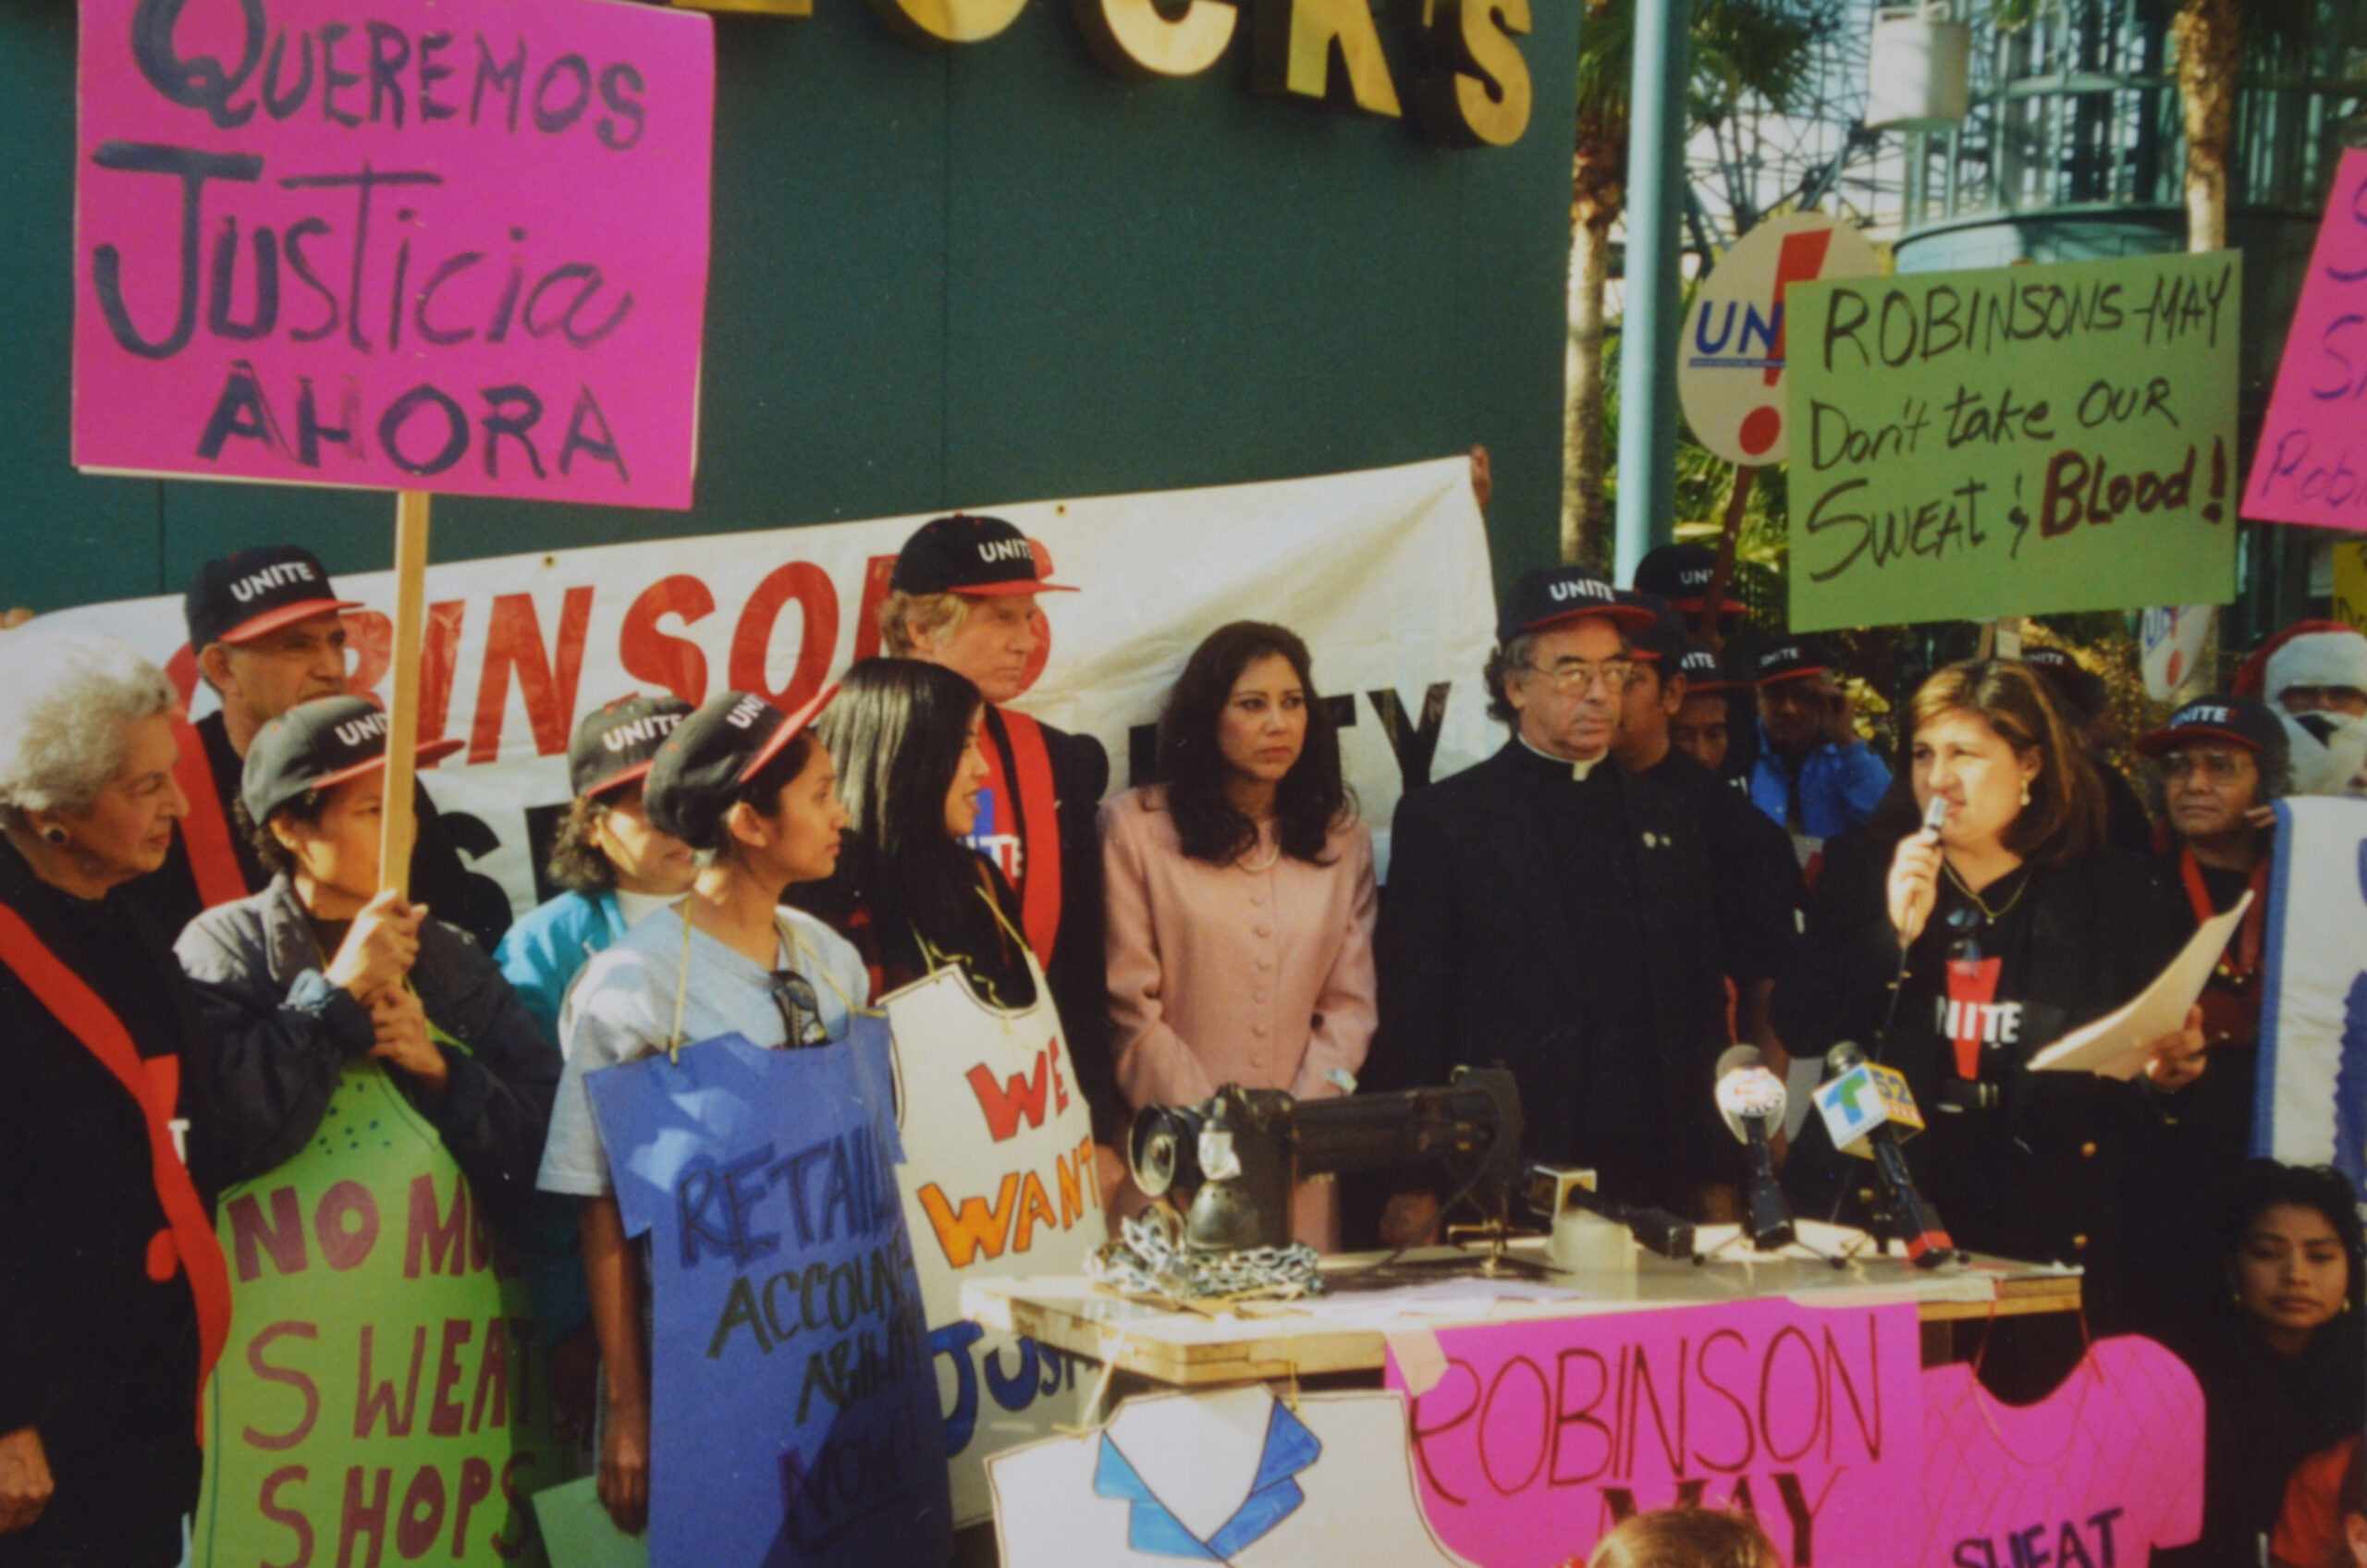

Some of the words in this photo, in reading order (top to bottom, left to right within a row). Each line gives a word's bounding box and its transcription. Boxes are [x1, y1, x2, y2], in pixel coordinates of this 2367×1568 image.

[131, 0, 647, 151] QUEREMOS
[196, 361, 632, 484] AHORA
[1944, 386, 2054, 448] take
[2077, 377, 2179, 429] OUR
[1807, 475, 1988, 582] SWEAT
[1550, 579, 1616, 603] UNITE
[965, 1035, 1069, 1143] WE
[1870, 1070, 1914, 1107] 52
[227, 1179, 381, 1283] NO
[917, 1135, 1101, 1269] WANT
[242, 1317, 536, 1452] SWEAT
[1410, 1313, 1883, 1506] ROBINSON
[258, 1450, 538, 1568] SHOPS
